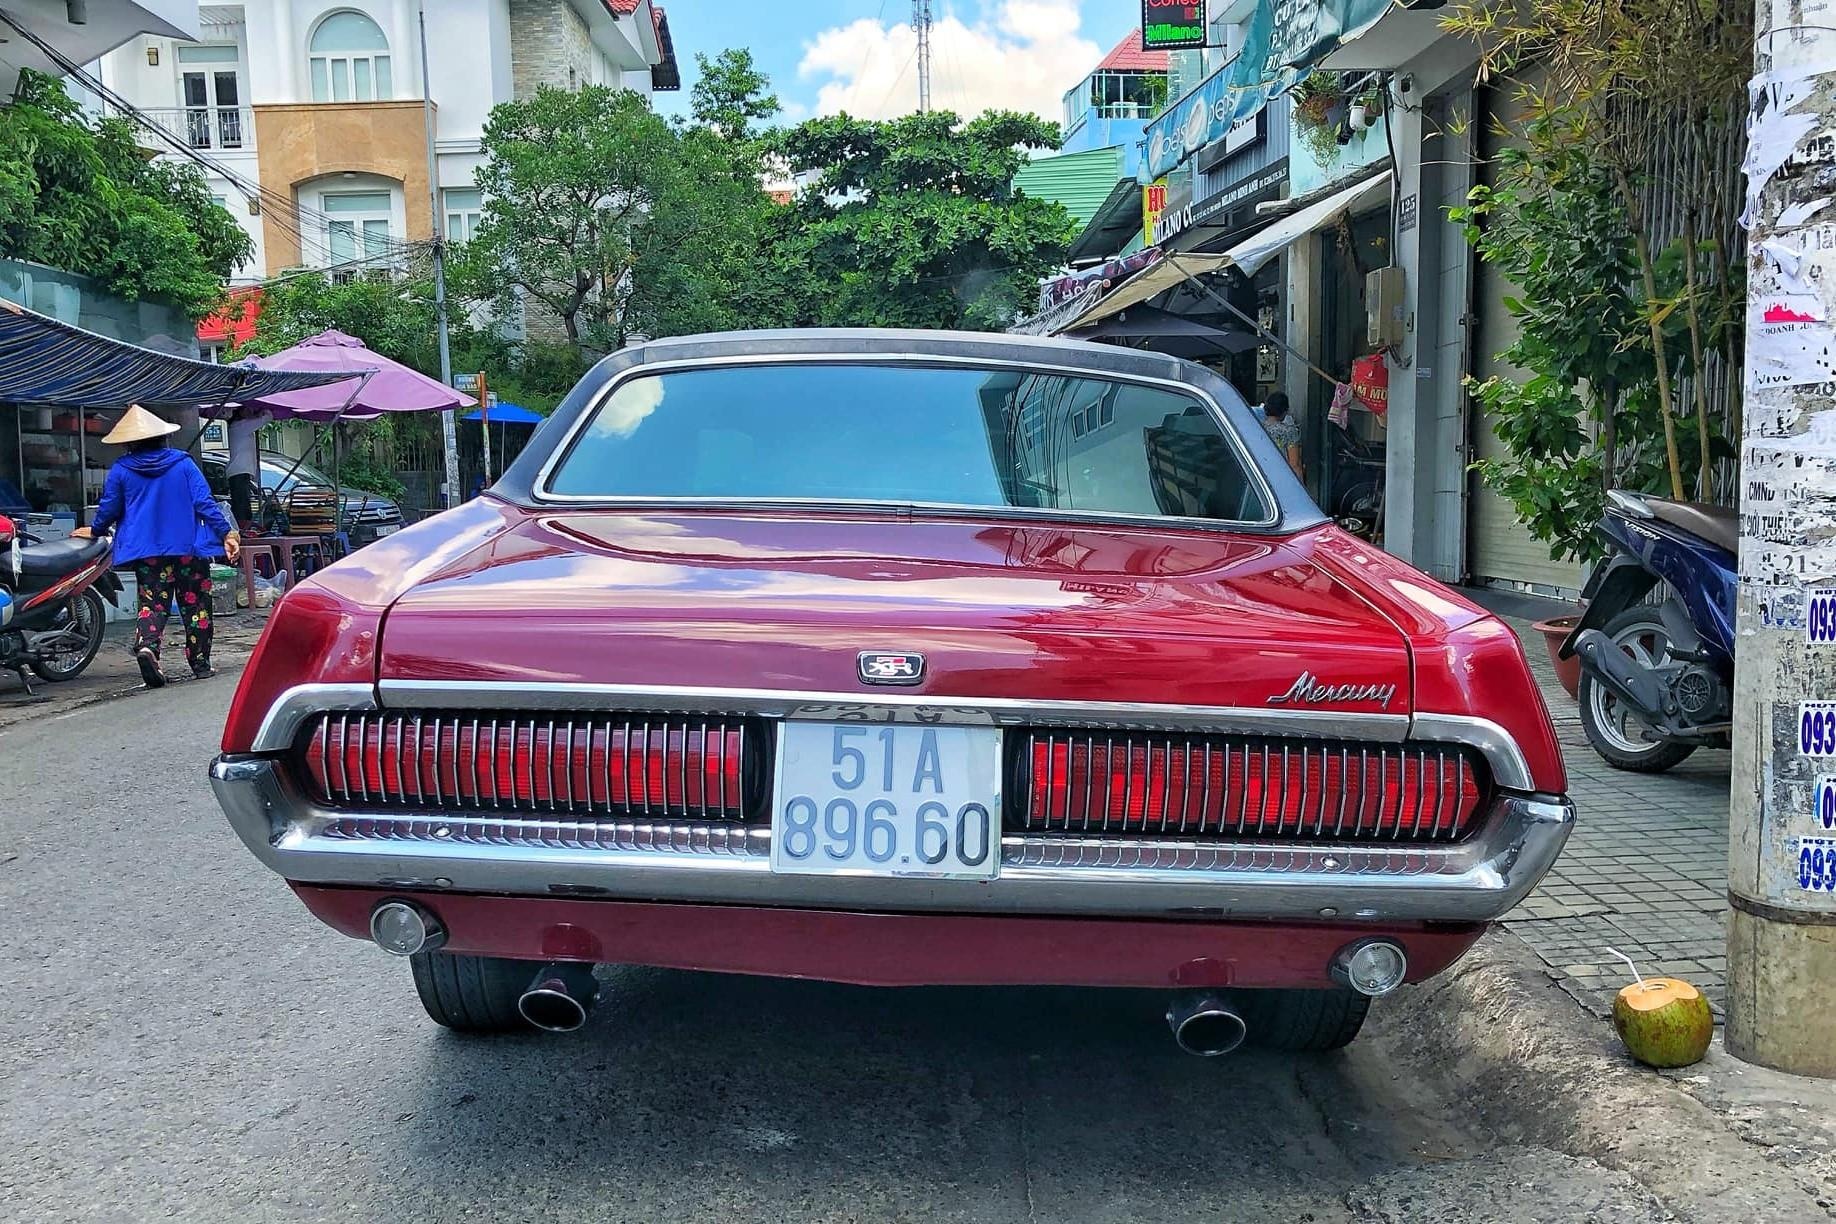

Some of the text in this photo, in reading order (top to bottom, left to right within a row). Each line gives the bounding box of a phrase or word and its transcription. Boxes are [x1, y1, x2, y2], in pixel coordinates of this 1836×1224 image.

[1810, 598, 1836, 641] 093
[1266, 670, 1397, 710] Mercury
[1801, 711, 1836, 755] 093
[832, 727, 943, 792] 51A
[783, 796, 989, 866] 896.60
[1800, 847, 1836, 890] 093
